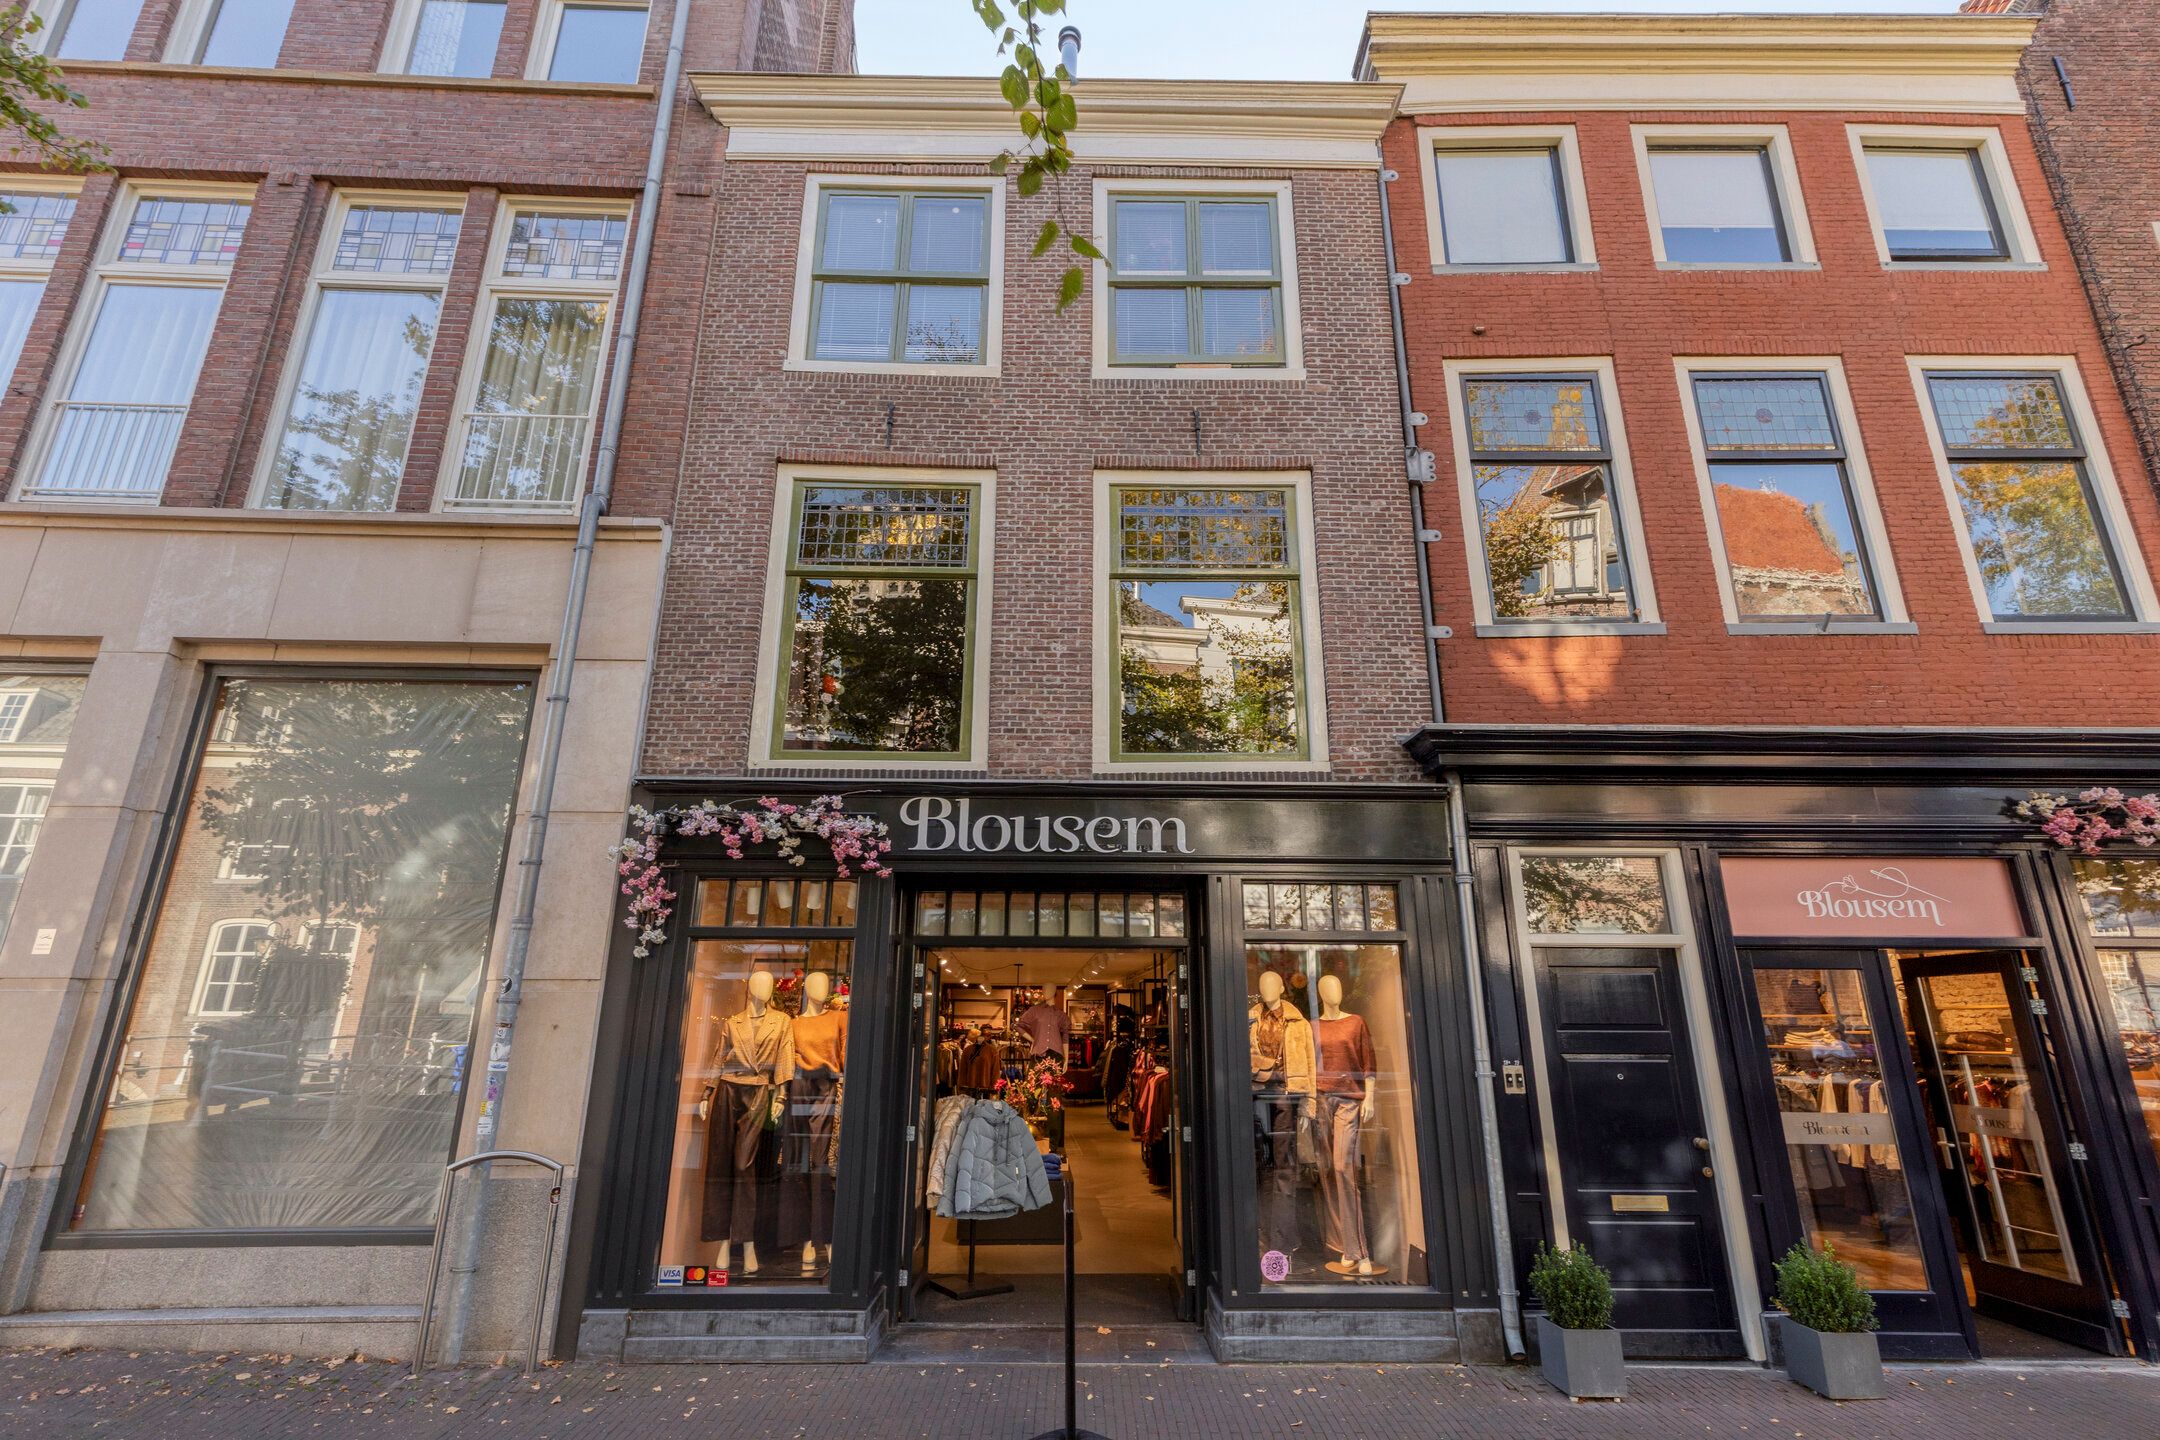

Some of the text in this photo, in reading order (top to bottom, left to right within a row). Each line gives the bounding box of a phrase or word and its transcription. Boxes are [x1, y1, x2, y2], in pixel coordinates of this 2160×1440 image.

[899, 796, 1196, 854] Blousem
[1797, 890, 1945, 926] Blousem
[663, 1269, 681, 1278] VISA
